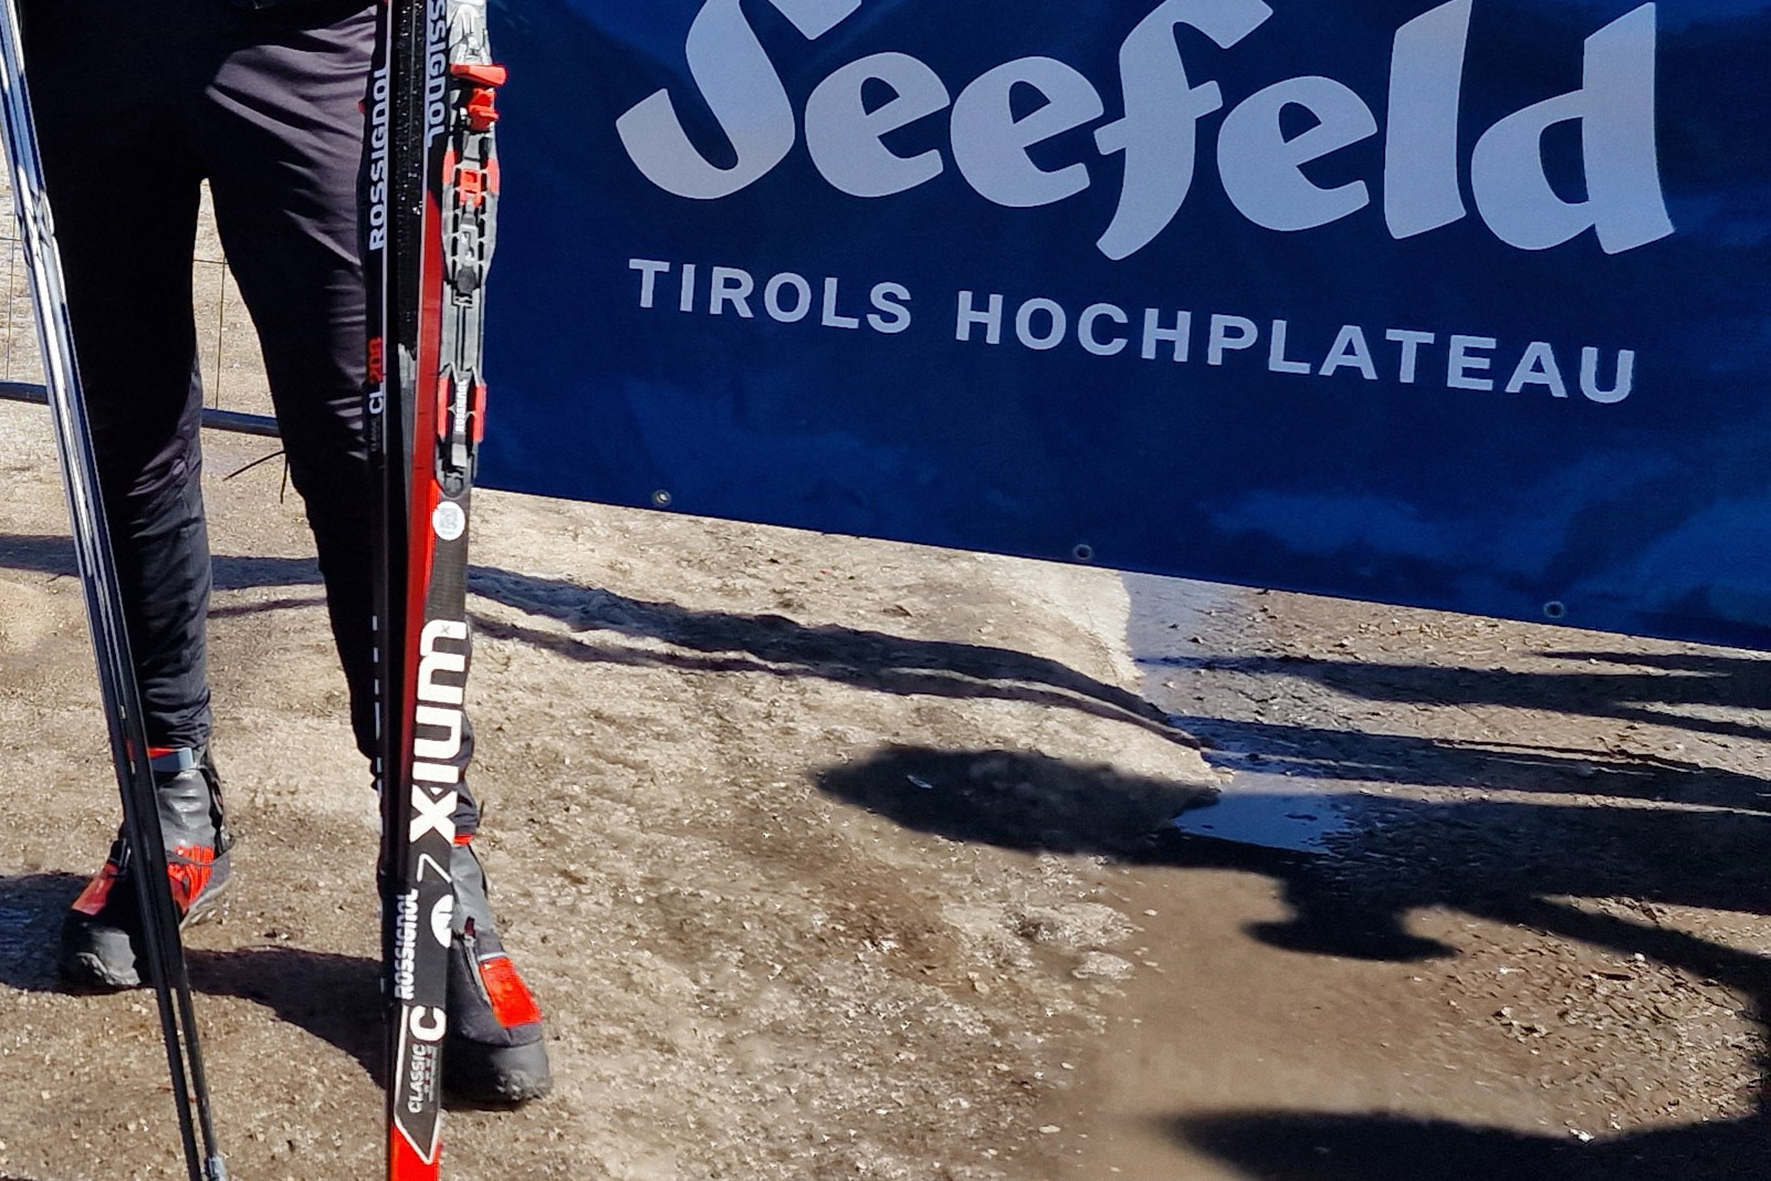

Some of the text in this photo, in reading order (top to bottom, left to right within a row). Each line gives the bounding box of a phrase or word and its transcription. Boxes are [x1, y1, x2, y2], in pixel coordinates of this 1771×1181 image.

[369, 65, 387, 251] ROSSIGNOL
[628, 256, 1637, 405] TIROLS HOCHPLATEAU
[394, 889, 419, 1000] ROSSIGNOL
[406, 1042, 427, 1115] CLASSIC
